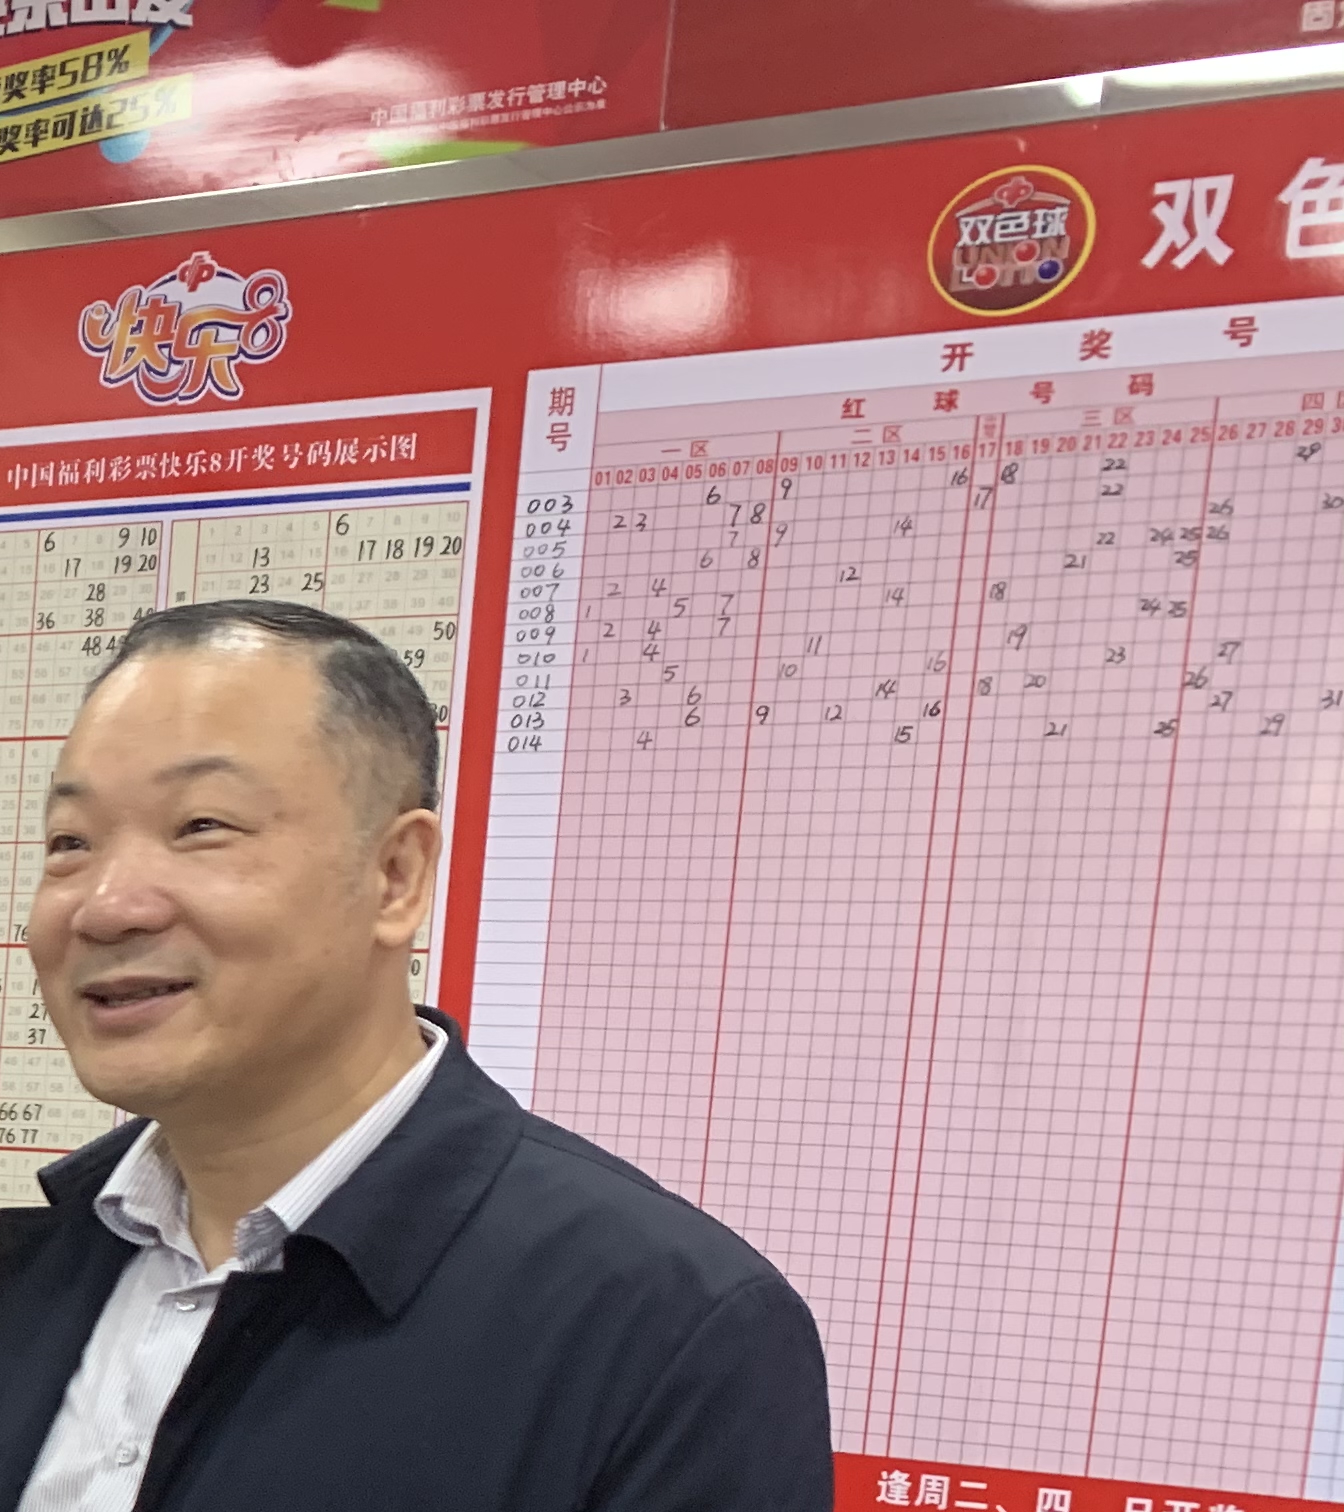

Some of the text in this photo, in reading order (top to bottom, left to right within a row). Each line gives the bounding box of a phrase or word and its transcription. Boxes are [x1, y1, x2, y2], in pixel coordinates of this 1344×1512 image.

[956, 206, 1069, 248] 双色球
[6, 432, 419, 492] 中国福利彩票快乐8开奖号码展示图
[527, 494, 574, 515] 003
[335, 513, 350, 536] 6
[526, 518, 571, 538] 004
[43, 532, 56, 553] 6
[118, 527, 130, 548] 9
[140, 526, 157, 547] 10
[523, 541, 566, 558] 005
[252, 534, 463, 568] 13 17 18 19 20
[64, 557, 81, 578] 17
[113, 553, 132, 574] 19
[137, 552, 158, 572] 20
[521, 563, 564, 579] 006
[86, 582, 106, 602] 28
[520, 582, 559, 600] 007
[36, 610, 56, 631] 36
[84, 607, 105, 628] 38
[518, 603, 555, 622] 008
[432, 620, 457, 642] 50
[516, 625, 555, 644] 009
[518, 651, 555, 666] 010
[517, 673, 551, 689] 011
[513, 691, 545, 709] 012
[511, 712, 545, 730] 013
[508, 735, 542, 752] 014
[22, 1101, 43, 1121] 67
